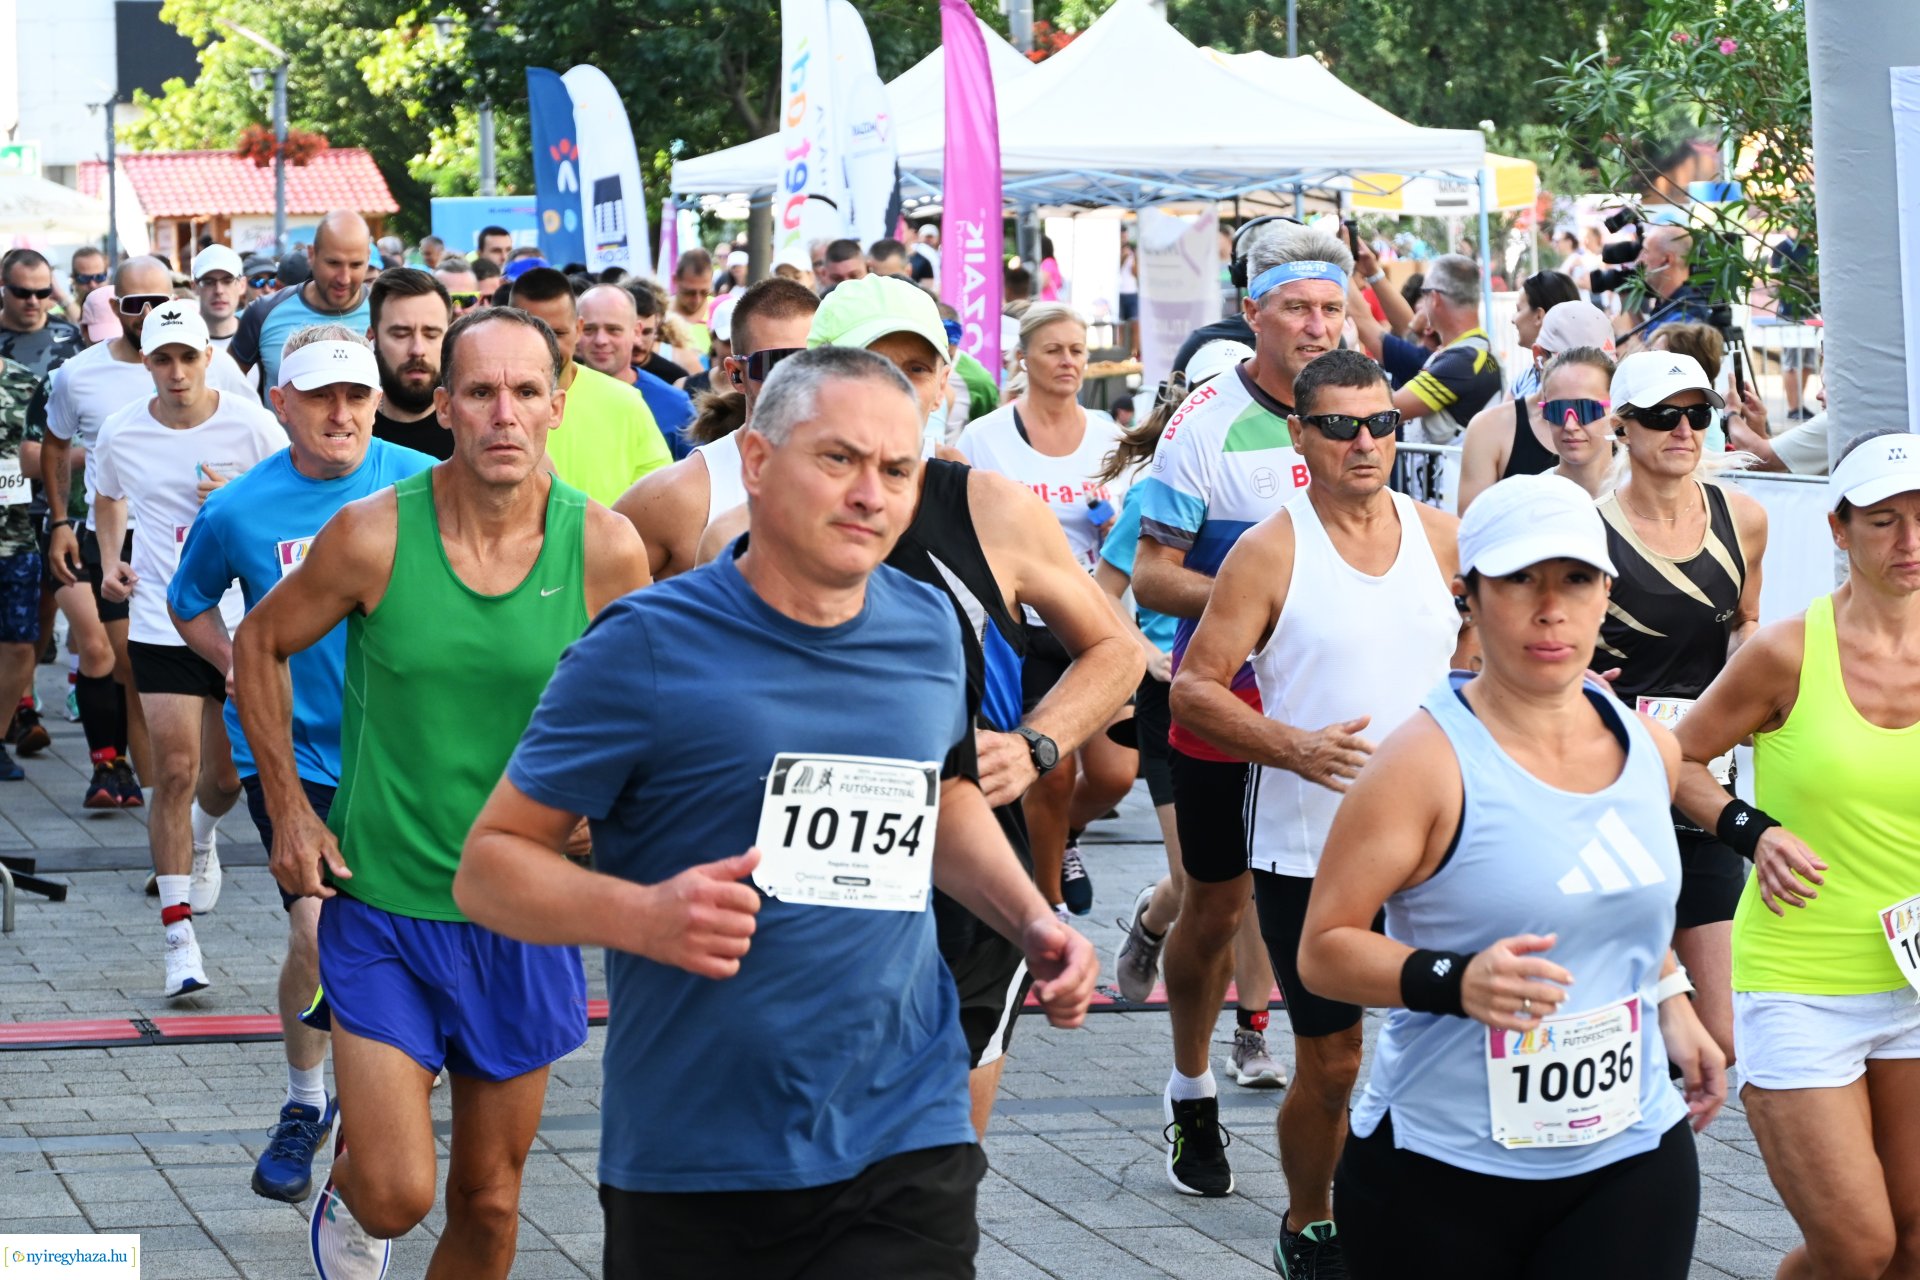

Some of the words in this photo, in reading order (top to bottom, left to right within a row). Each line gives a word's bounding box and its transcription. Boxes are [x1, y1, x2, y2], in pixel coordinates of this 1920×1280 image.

[1164, 385, 1218, 441] BOSCH
[0, 473, 25, 489] 069
[782, 805, 924, 857] 10154
[1512, 1041, 1633, 1104] 10036
